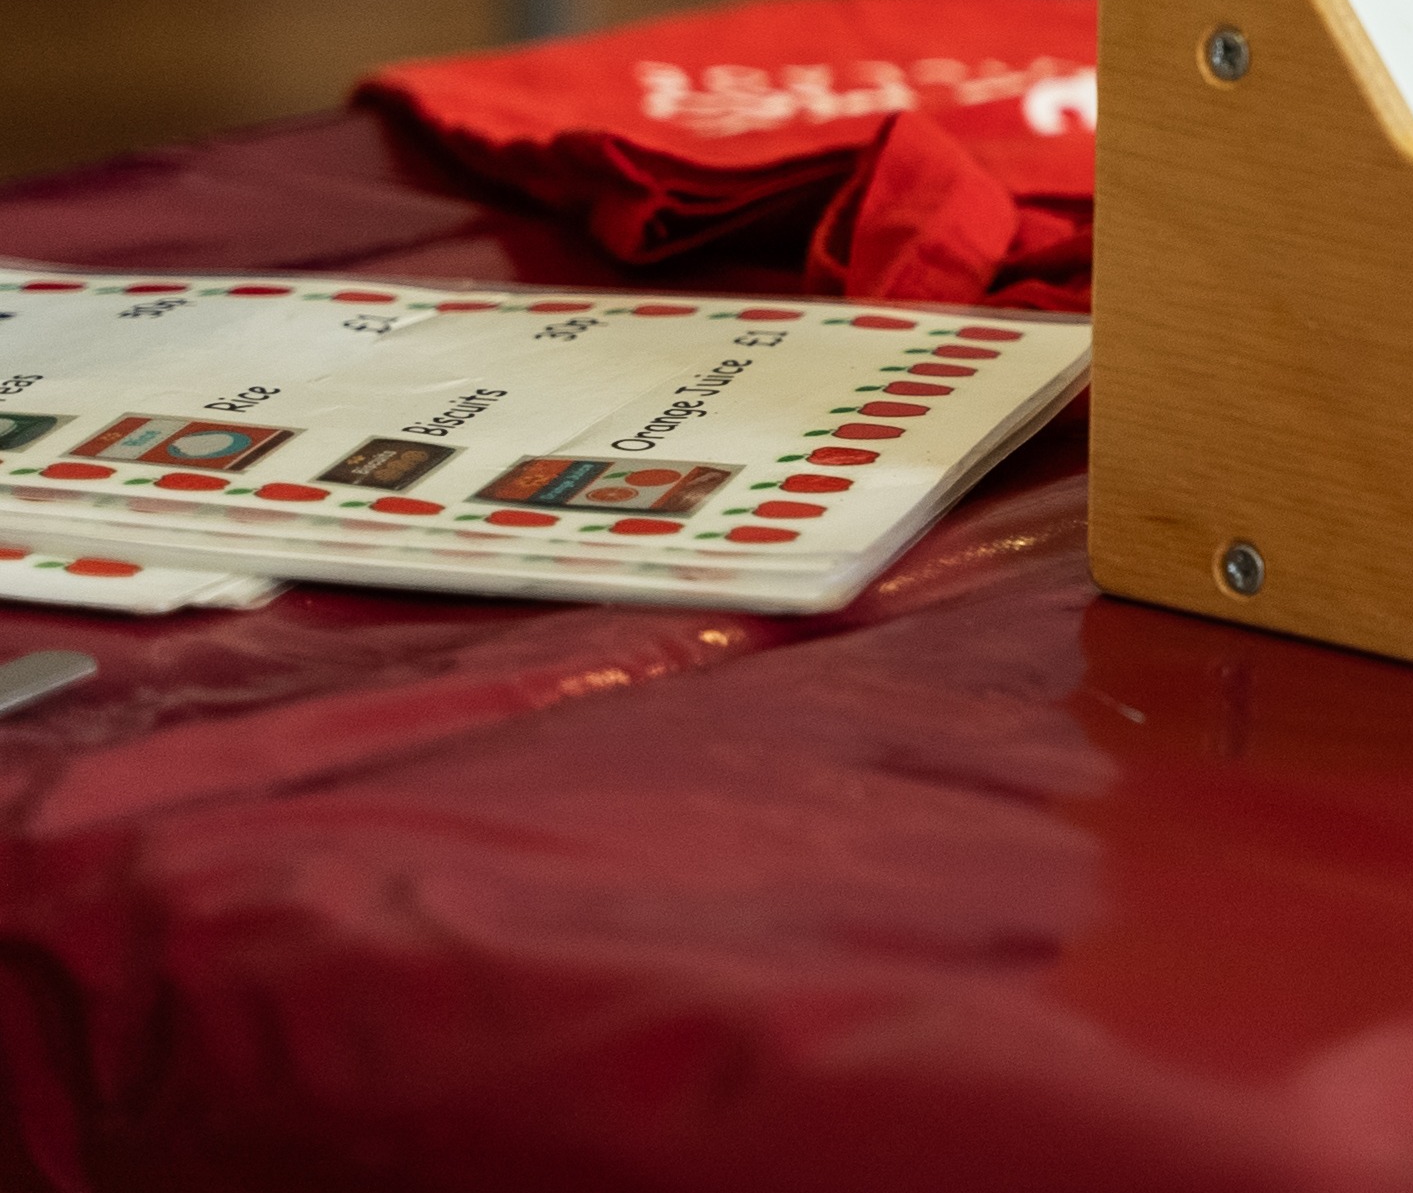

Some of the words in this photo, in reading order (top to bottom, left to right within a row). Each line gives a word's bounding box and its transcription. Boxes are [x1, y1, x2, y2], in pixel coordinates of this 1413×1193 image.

[732, 329, 789, 348] £1
[0, 374, 44, 402] eas
[204, 385, 281, 413] Rice
[401, 388, 508, 437] Biscuits
[611, 400, 708, 452] Orange
[674, 358, 753, 397] Juice
